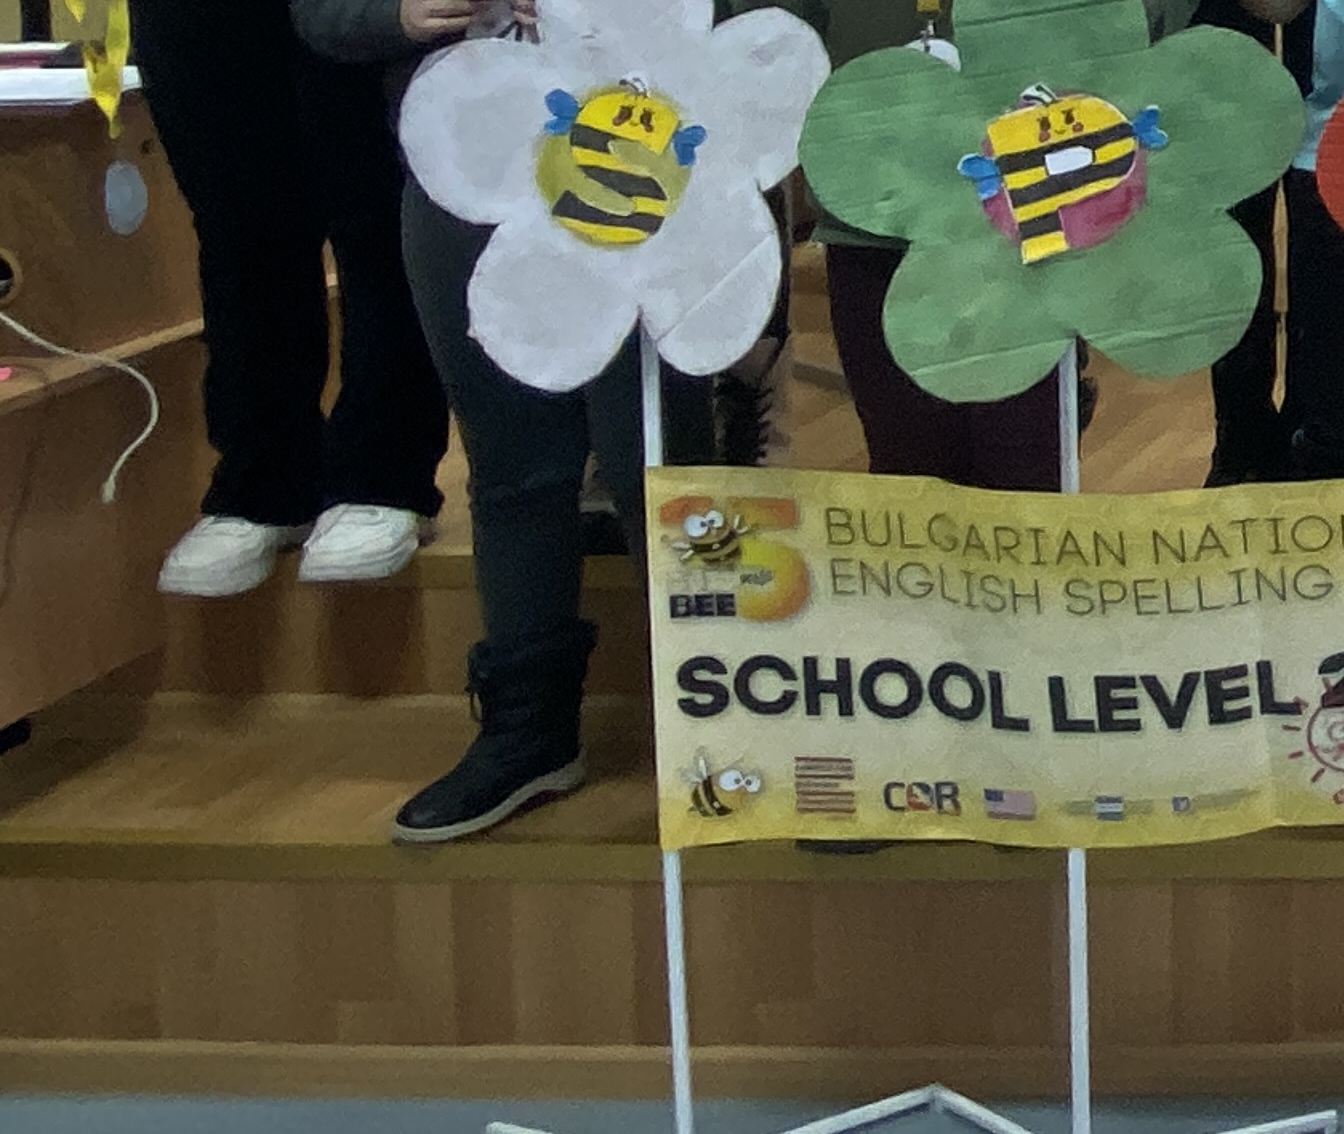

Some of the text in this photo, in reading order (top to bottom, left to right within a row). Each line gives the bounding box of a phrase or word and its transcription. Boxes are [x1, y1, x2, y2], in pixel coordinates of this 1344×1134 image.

[825, 507, 1126, 567] BULGARIAN
[669, 593, 737, 619] BEE
[831, 558, 1042, 616] ENGLISH
[1065, 564, 1334, 617] SPELLING
[676, 654, 1031, 733] SCHOOL
[1047, 659, 1304, 734] LEVEL
